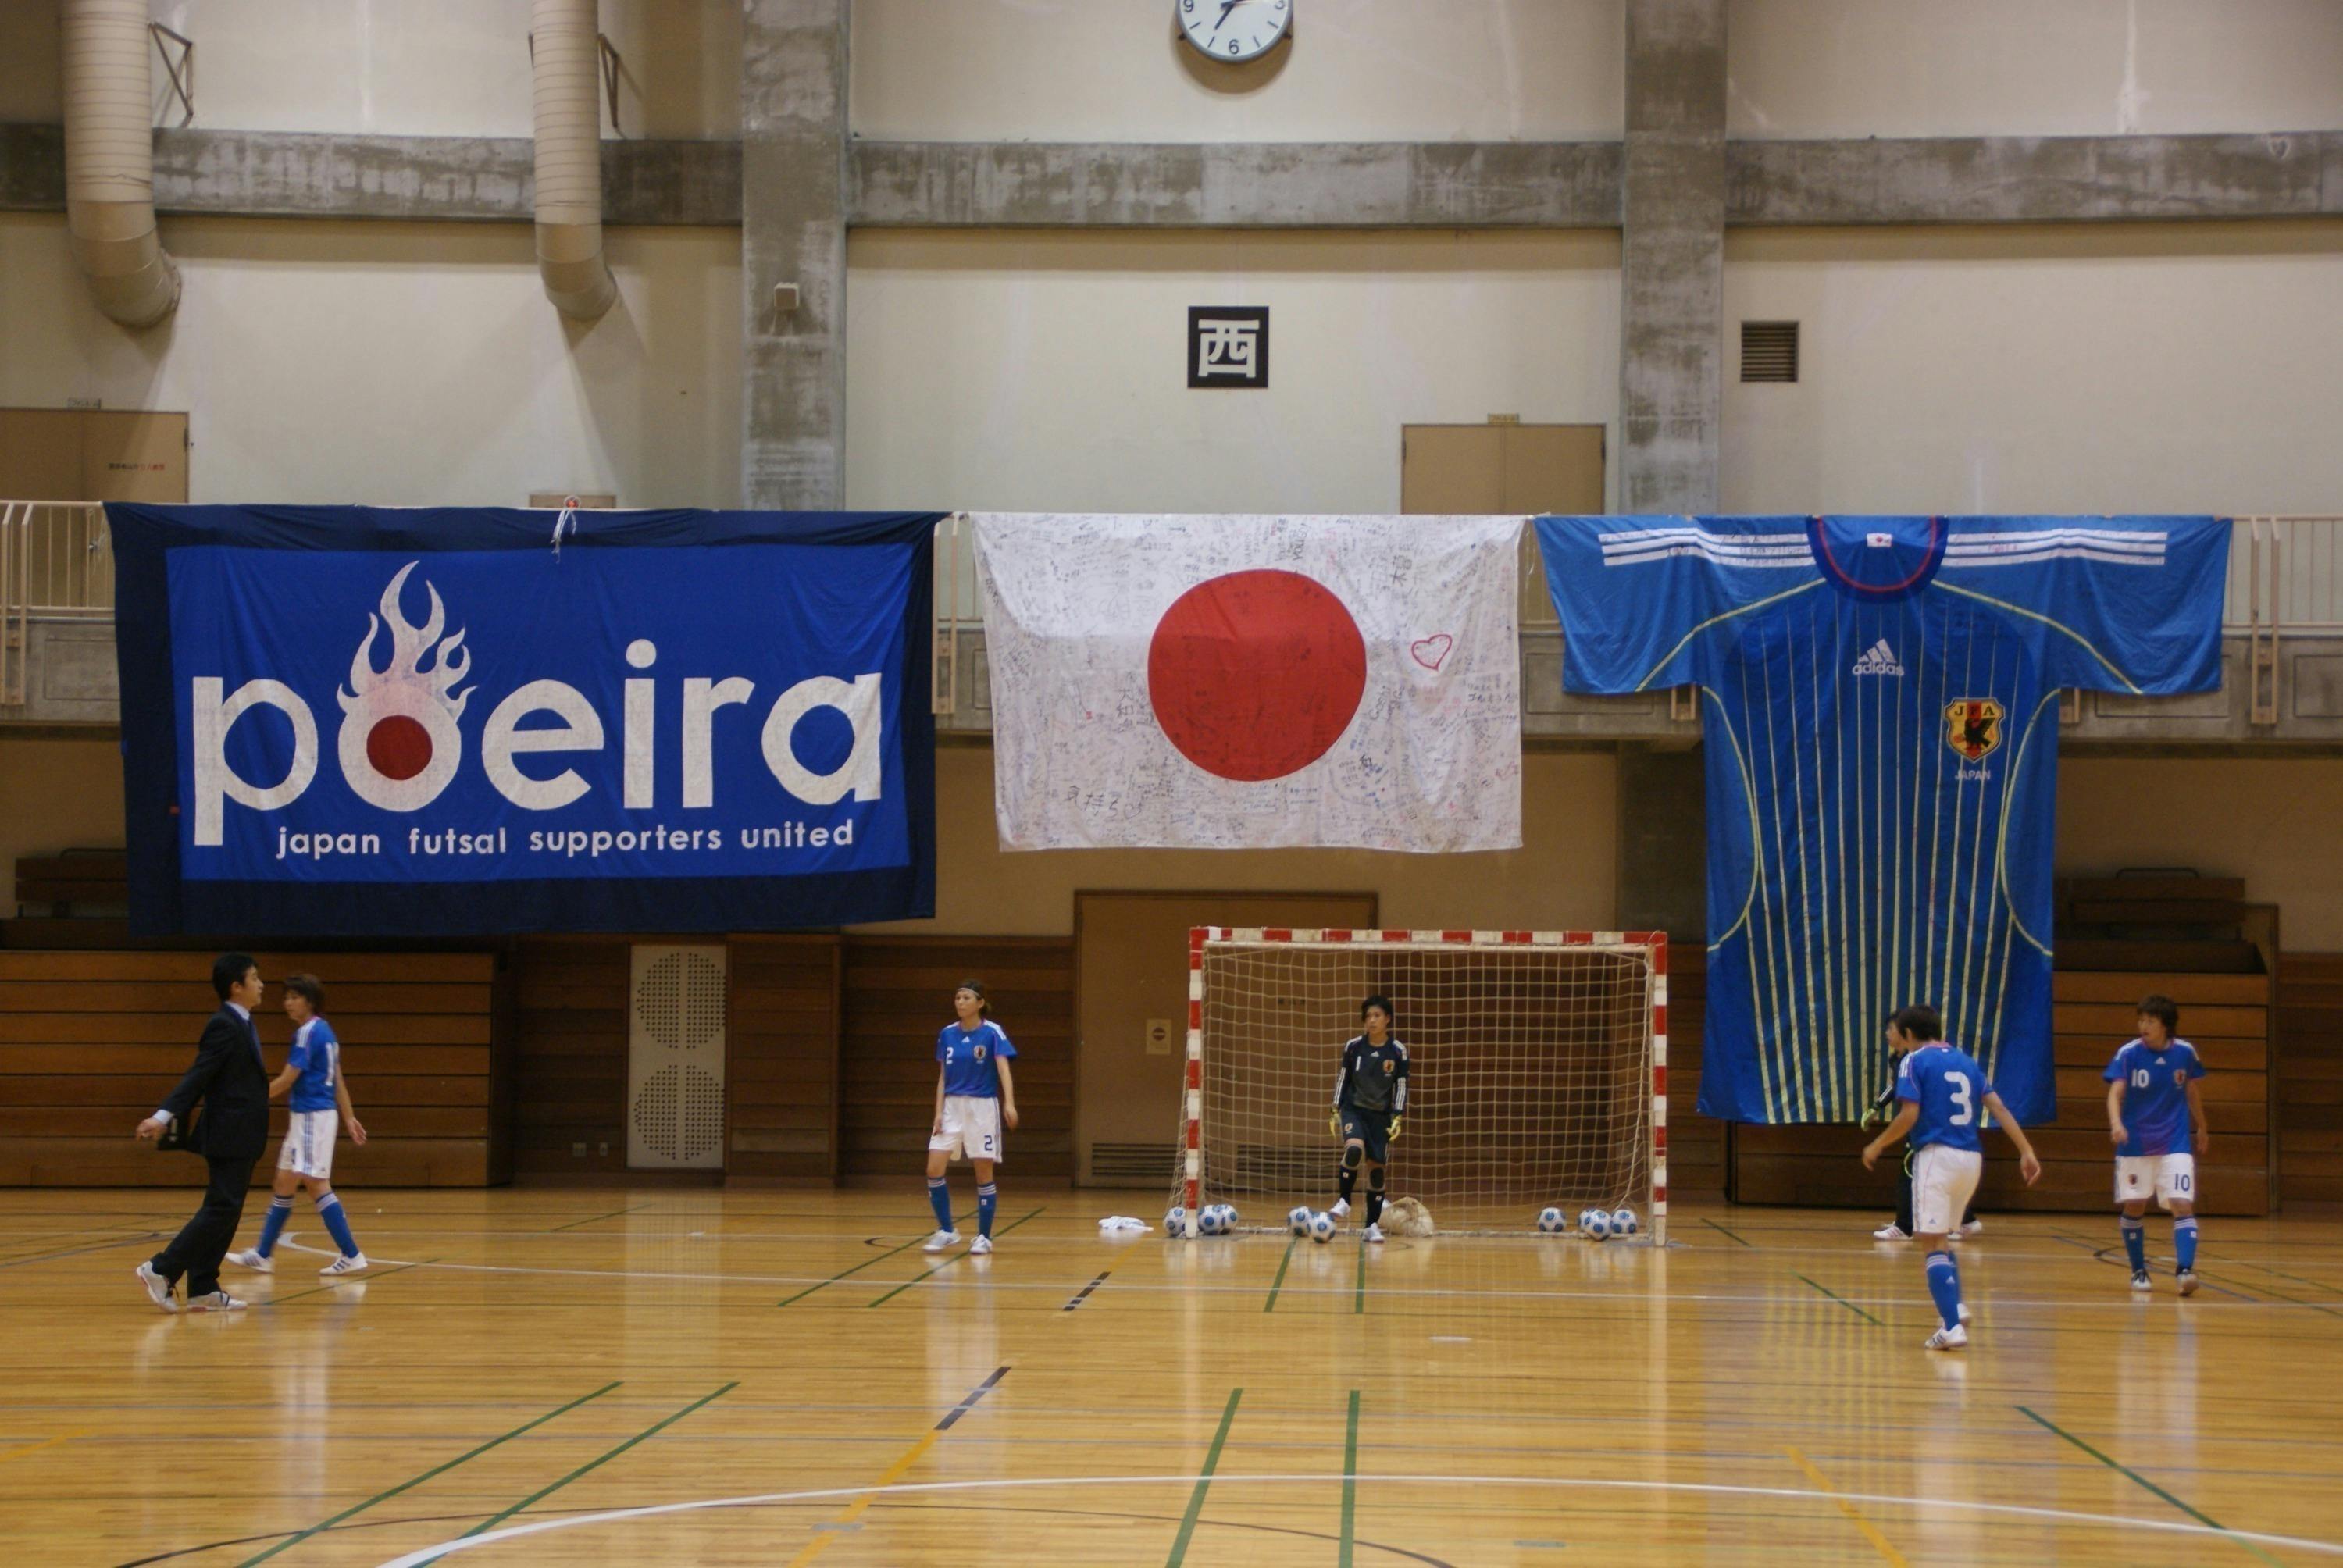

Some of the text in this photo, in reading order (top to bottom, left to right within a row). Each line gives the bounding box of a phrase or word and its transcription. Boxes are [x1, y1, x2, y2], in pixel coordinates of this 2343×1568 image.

[1229, 39, 1239, 55] 6
[1198, 319, 1260, 378] 西
[1852, 662, 1904, 676] adidas
[193, 639, 883, 846] poeira
[1955, 769, 1991, 781] JAPAN
[276, 819, 854, 861] japan futsal supporters united
[946, 1046, 954, 1064] 2
[1356, 1056, 1361, 1071] 1
[2131, 1068, 2149, 1088] 10
[1944, 1071, 1973, 1126] 3
[984, 1135, 993, 1151] 2
[2174, 1173, 2191, 1192] 10
